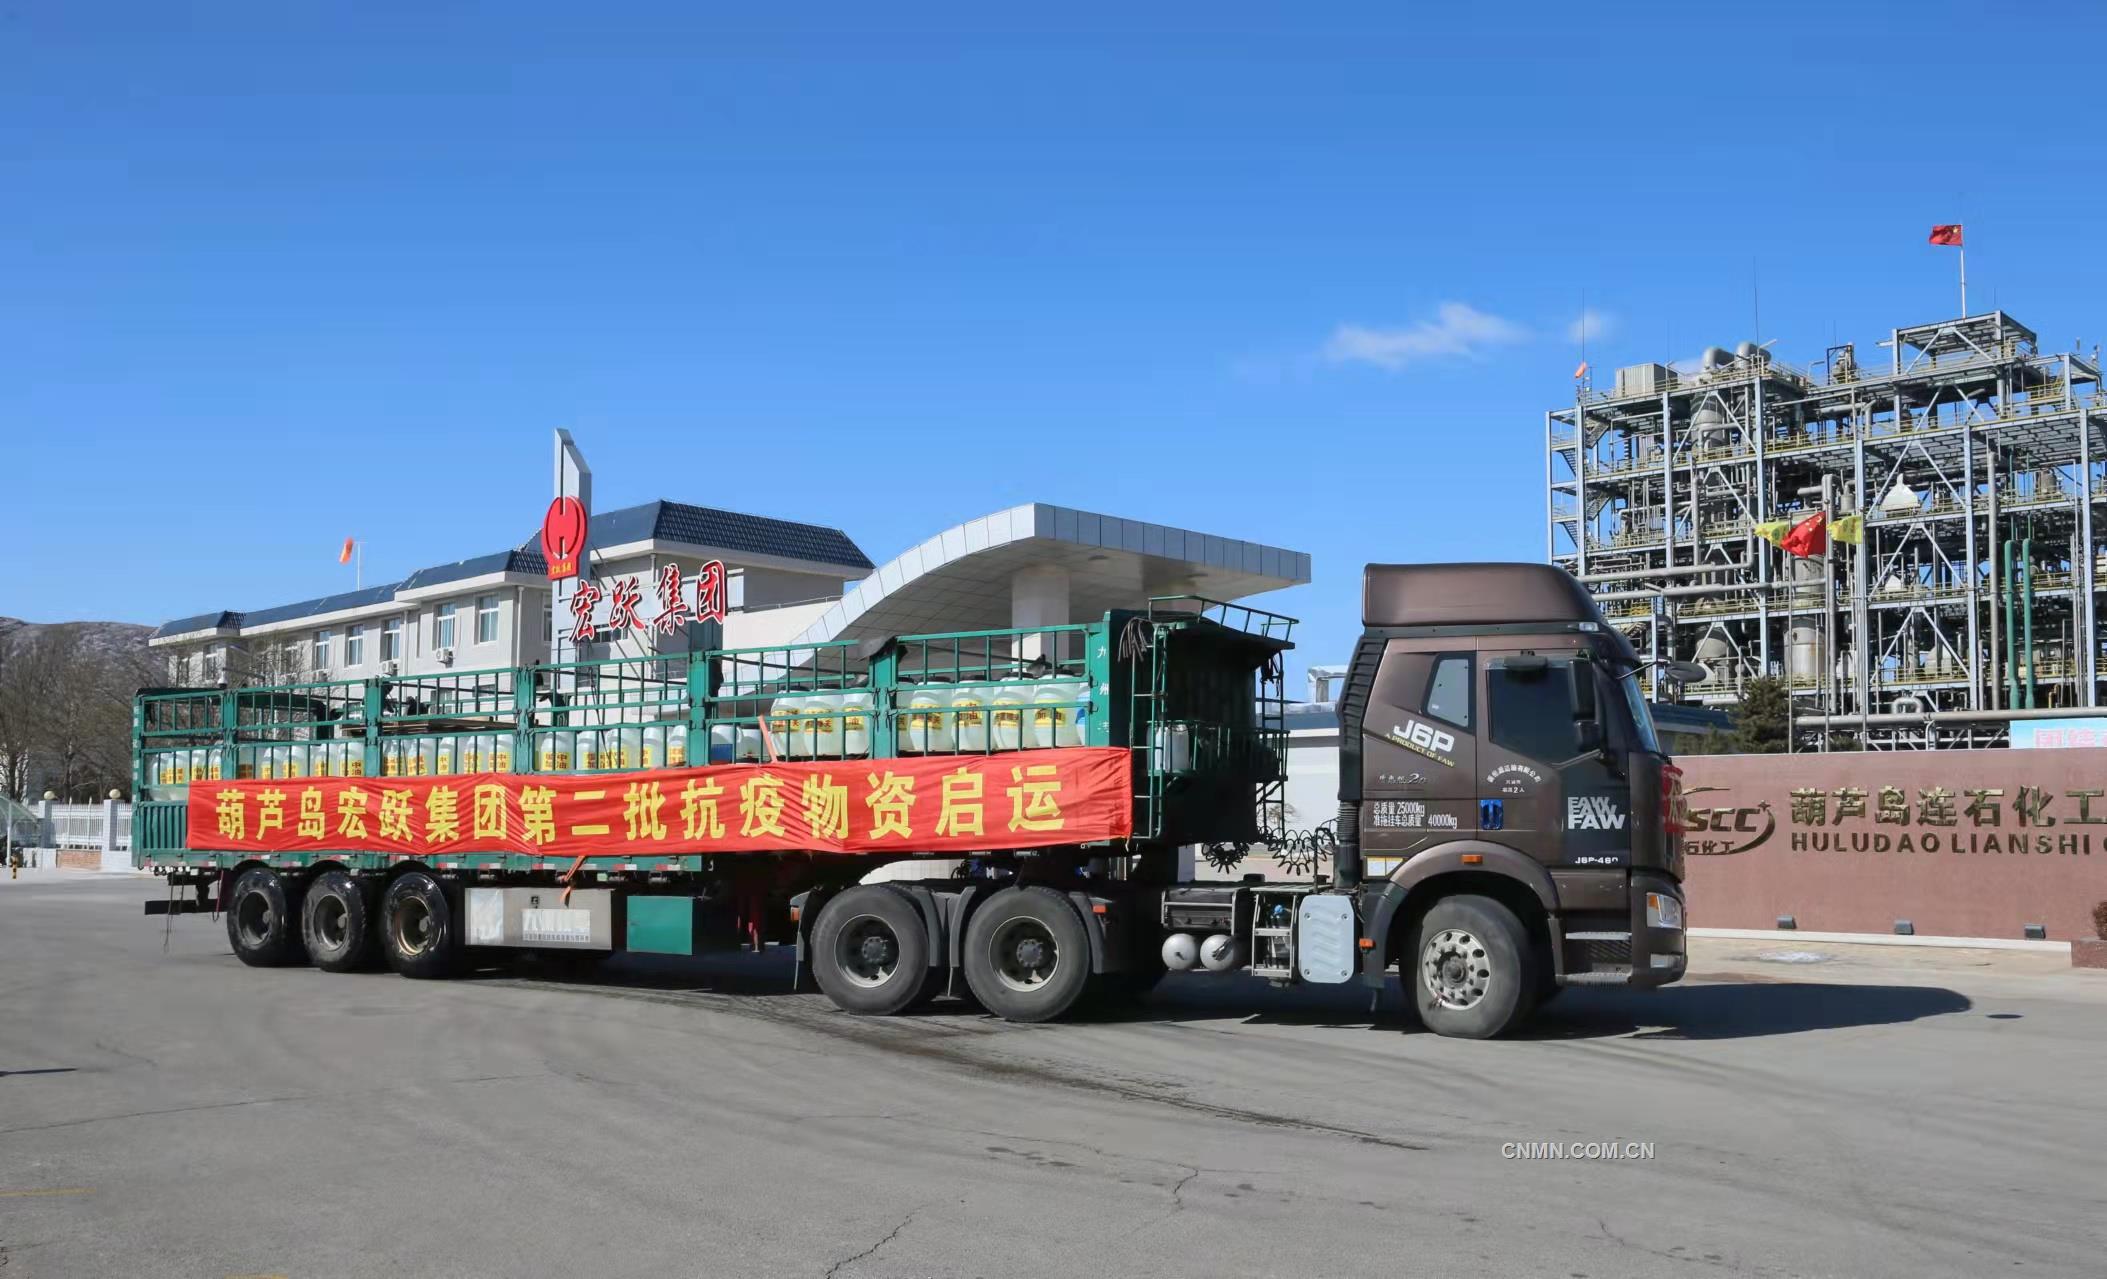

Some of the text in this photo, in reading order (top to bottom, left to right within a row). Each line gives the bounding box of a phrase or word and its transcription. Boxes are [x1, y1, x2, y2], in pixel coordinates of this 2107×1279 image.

[569, 560, 728, 643] 宏跃集团
[1393, 720, 1455, 752] J6P
[215, 764, 1066, 846] 葫芦岛宏跃集团第二批抗疫物资启运
[1373, 802, 1425, 818] 总质量 25000kg
[1790, 784, 2107, 829] 葫芦岛连石化工
[1373, 814, 1458, 830] 准拖挂车总质量 40000kg
[1568, 814, 1626, 830] FAW
[1791, 832, 1941, 853] HULUDAO
[1951, 832, 2091, 856] LIANSHI
